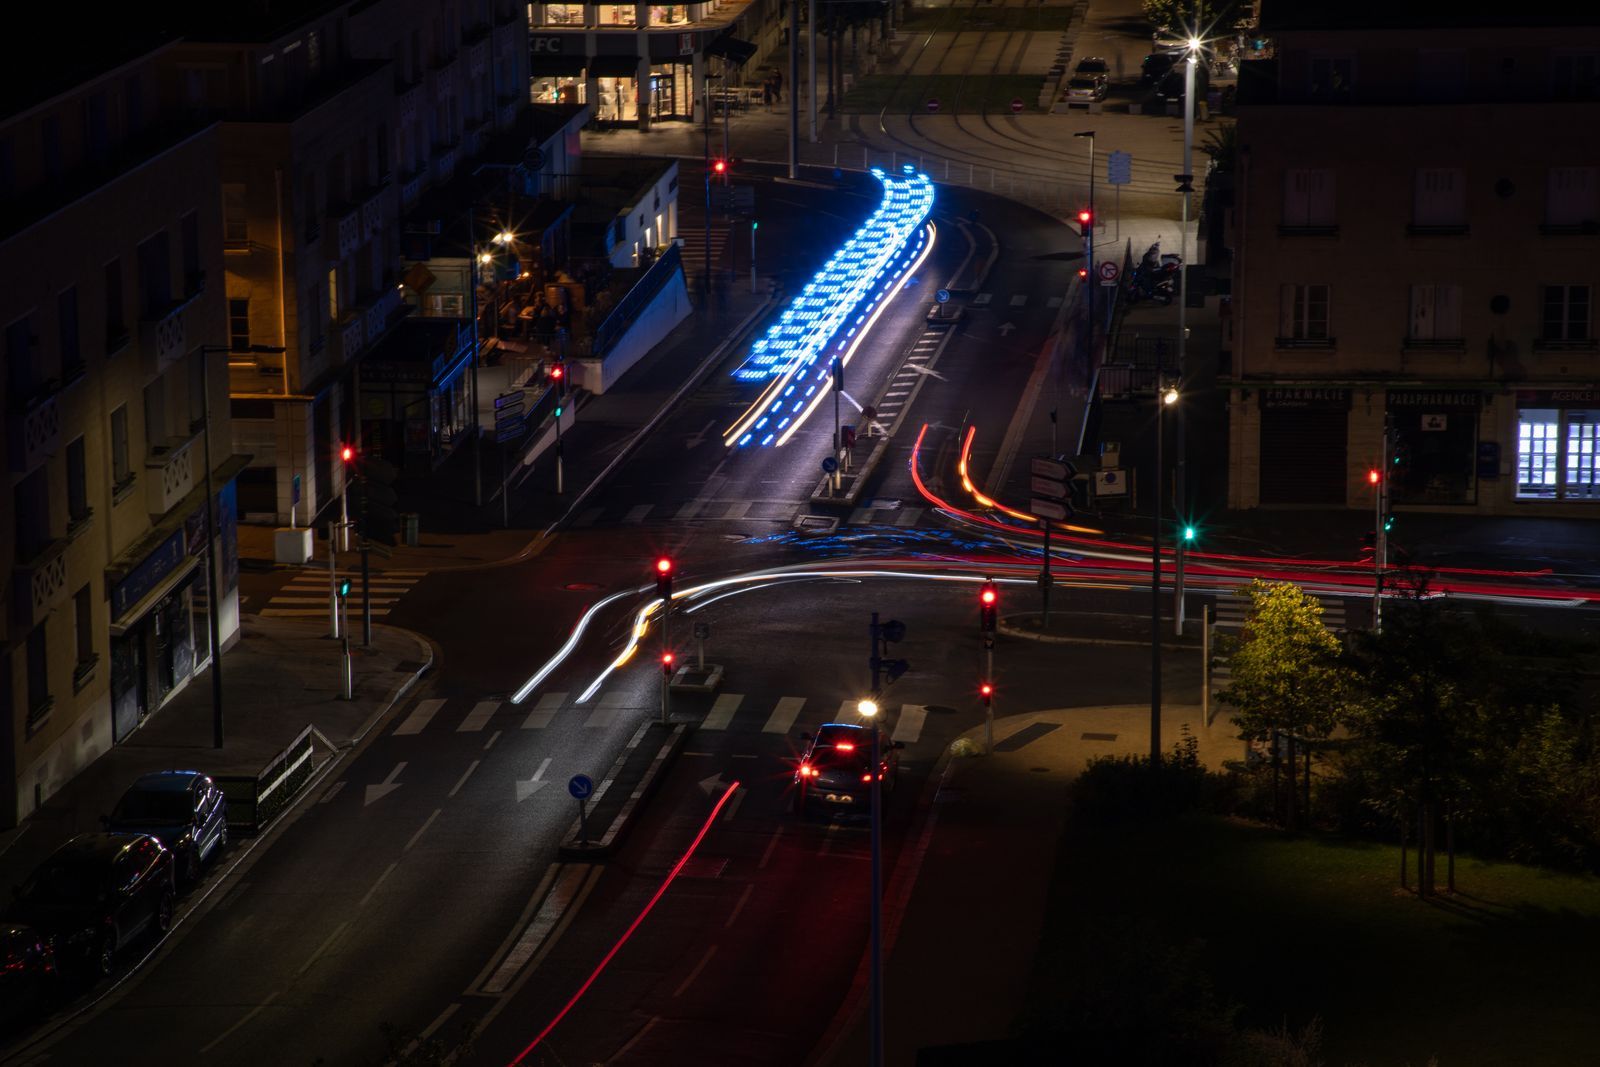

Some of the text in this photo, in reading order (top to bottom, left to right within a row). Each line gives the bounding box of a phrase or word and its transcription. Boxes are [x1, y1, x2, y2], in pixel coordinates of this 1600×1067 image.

[1265, 390, 1345, 400] PHARMACIE
[1389, 392, 1477, 406] PARAPHARMACIE
[1551, 391, 1592, 401] AGENCE
